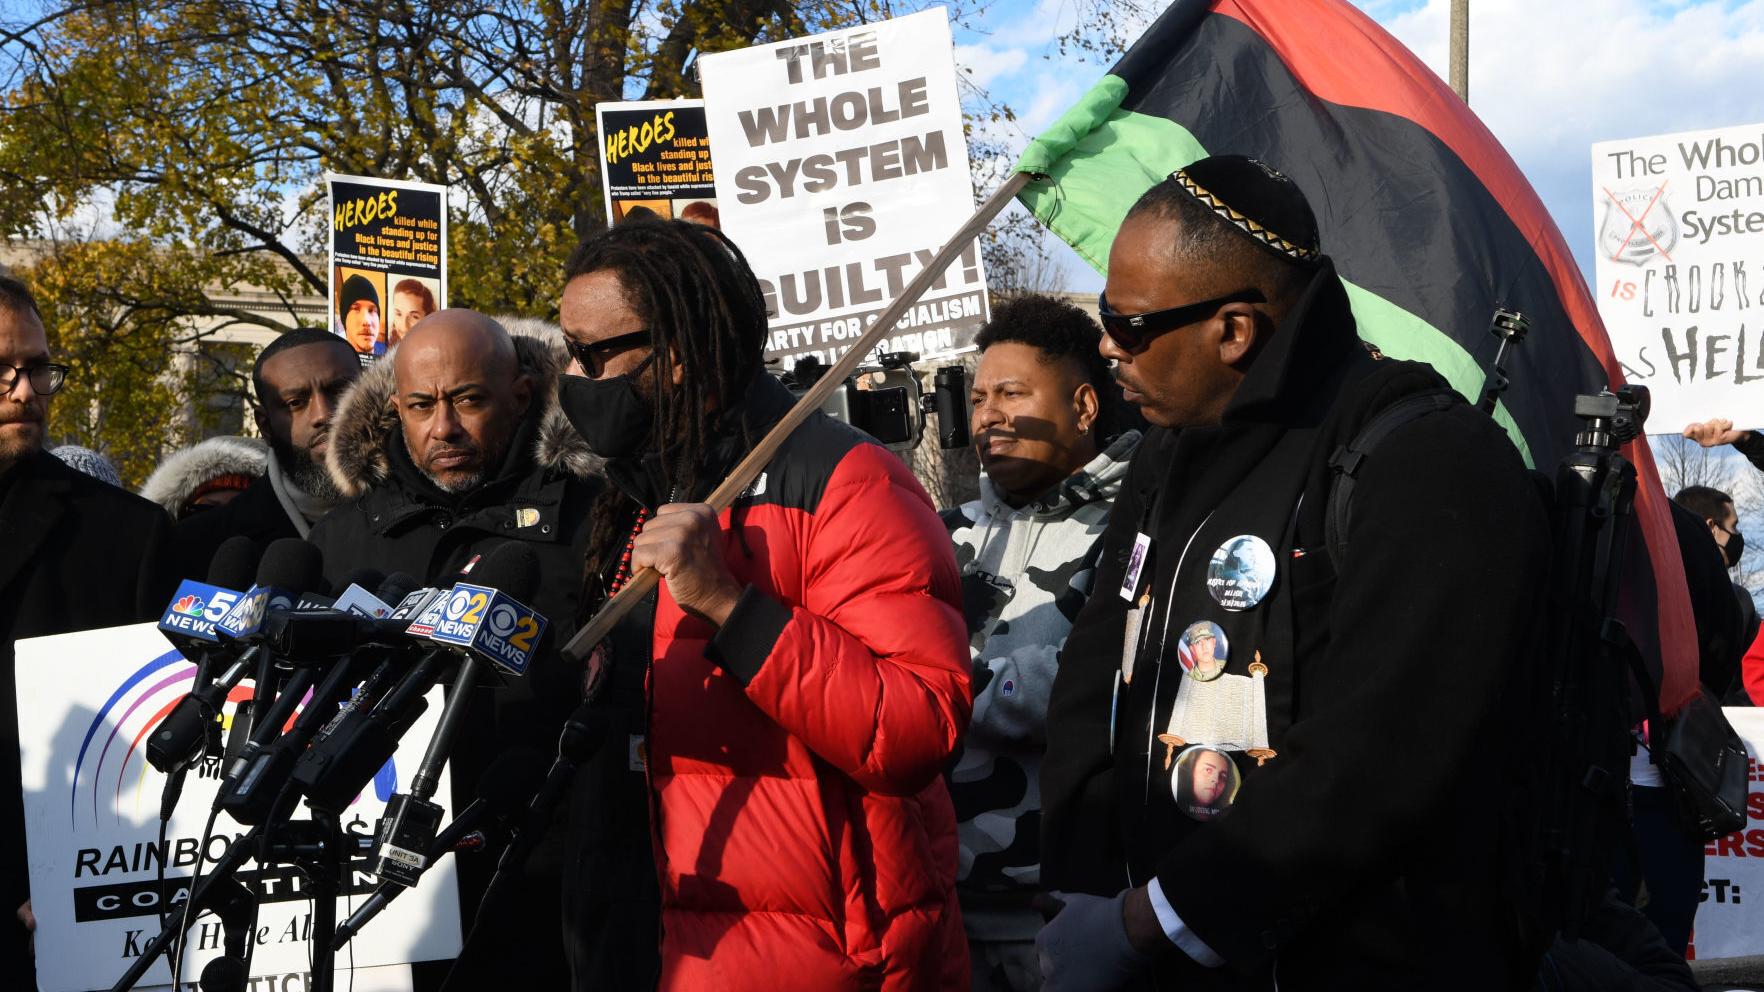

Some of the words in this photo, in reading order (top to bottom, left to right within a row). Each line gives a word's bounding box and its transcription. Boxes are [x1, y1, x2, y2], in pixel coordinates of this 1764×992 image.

[776, 31, 880, 84] THE
[738, 76, 929, 148] WHOLE
[606, 111, 675, 165] HEROES
[673, 137, 697, 147] killed
[632, 162, 654, 173] Black
[657, 162, 676, 172] lives
[678, 161, 693, 170] and
[661, 150, 697, 160] standing
[698, 150, 709, 160] up
[735, 130, 948, 205] SYSTEM
[1607, 150, 1667, 179] The
[638, 174, 645, 183] in
[647, 174, 660, 183] the
[663, 172, 699, 183] beautiful
[1696, 175, 1763, 202] Dam
[334, 190, 398, 232] HEROES
[394, 216, 416, 227] killed
[418, 218, 438, 230] while
[823, 201, 877, 246] IS
[1681, 208, 1764, 244] Syste
[355, 233, 375, 244] Black
[377, 236, 395, 247] lives
[396, 239, 410, 249] and
[412, 240, 438, 252] justice
[382, 226, 414, 240] standing
[416, 231, 425, 241] up
[427, 231, 438, 241] for
[359, 245, 366, 255] in
[368, 246, 379, 257] the
[381, 247, 415, 260] beautiful
[417, 252, 438, 265] rising
[1611, 279, 1637, 301] IS
[766, 325, 815, 351] ARTY
[820, 317, 862, 343] FOR
[866, 295, 981, 332] SCIALISM
[204, 591, 238, 622] 5
[461, 592, 488, 625] 2
[165, 614, 217, 636] NEWS
[437, 619, 474, 638] NEWS
[510, 616, 539, 652] 2
[479, 630, 526, 665] NEWS
[74, 831, 252, 879] RAINBO
[389, 849, 407, 860] UNIT
[408, 855, 420, 864] 3A
[391, 860, 415, 871] SONY
[96, 870, 379, 911] COATIN
[121, 930, 188, 960] Ke
[198, 922, 270, 958] He
